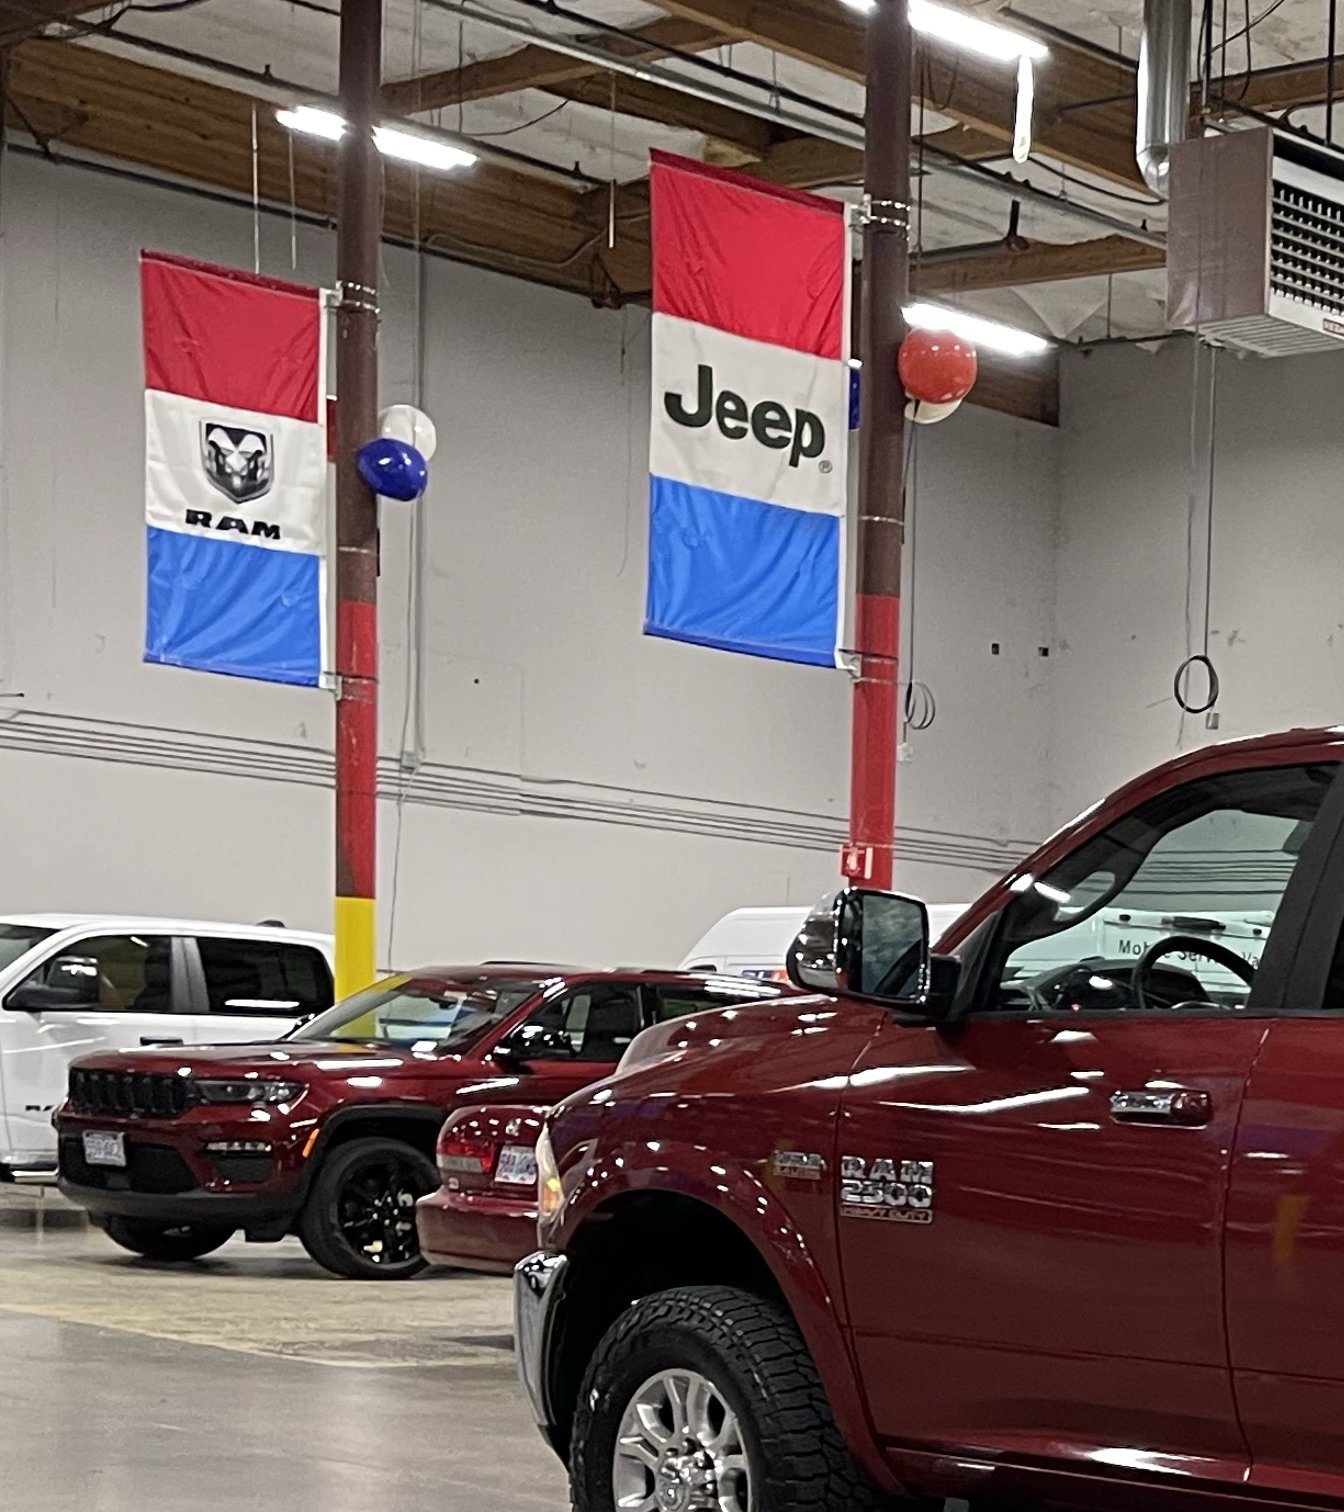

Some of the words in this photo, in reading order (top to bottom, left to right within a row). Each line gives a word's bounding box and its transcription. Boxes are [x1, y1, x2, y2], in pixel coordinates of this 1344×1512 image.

[664, 364, 826, 468] Jeep
[185, 509, 281, 540] RAM
[841, 1156, 934, 1184] RAM
[841, 1178, 933, 1209] 2500
